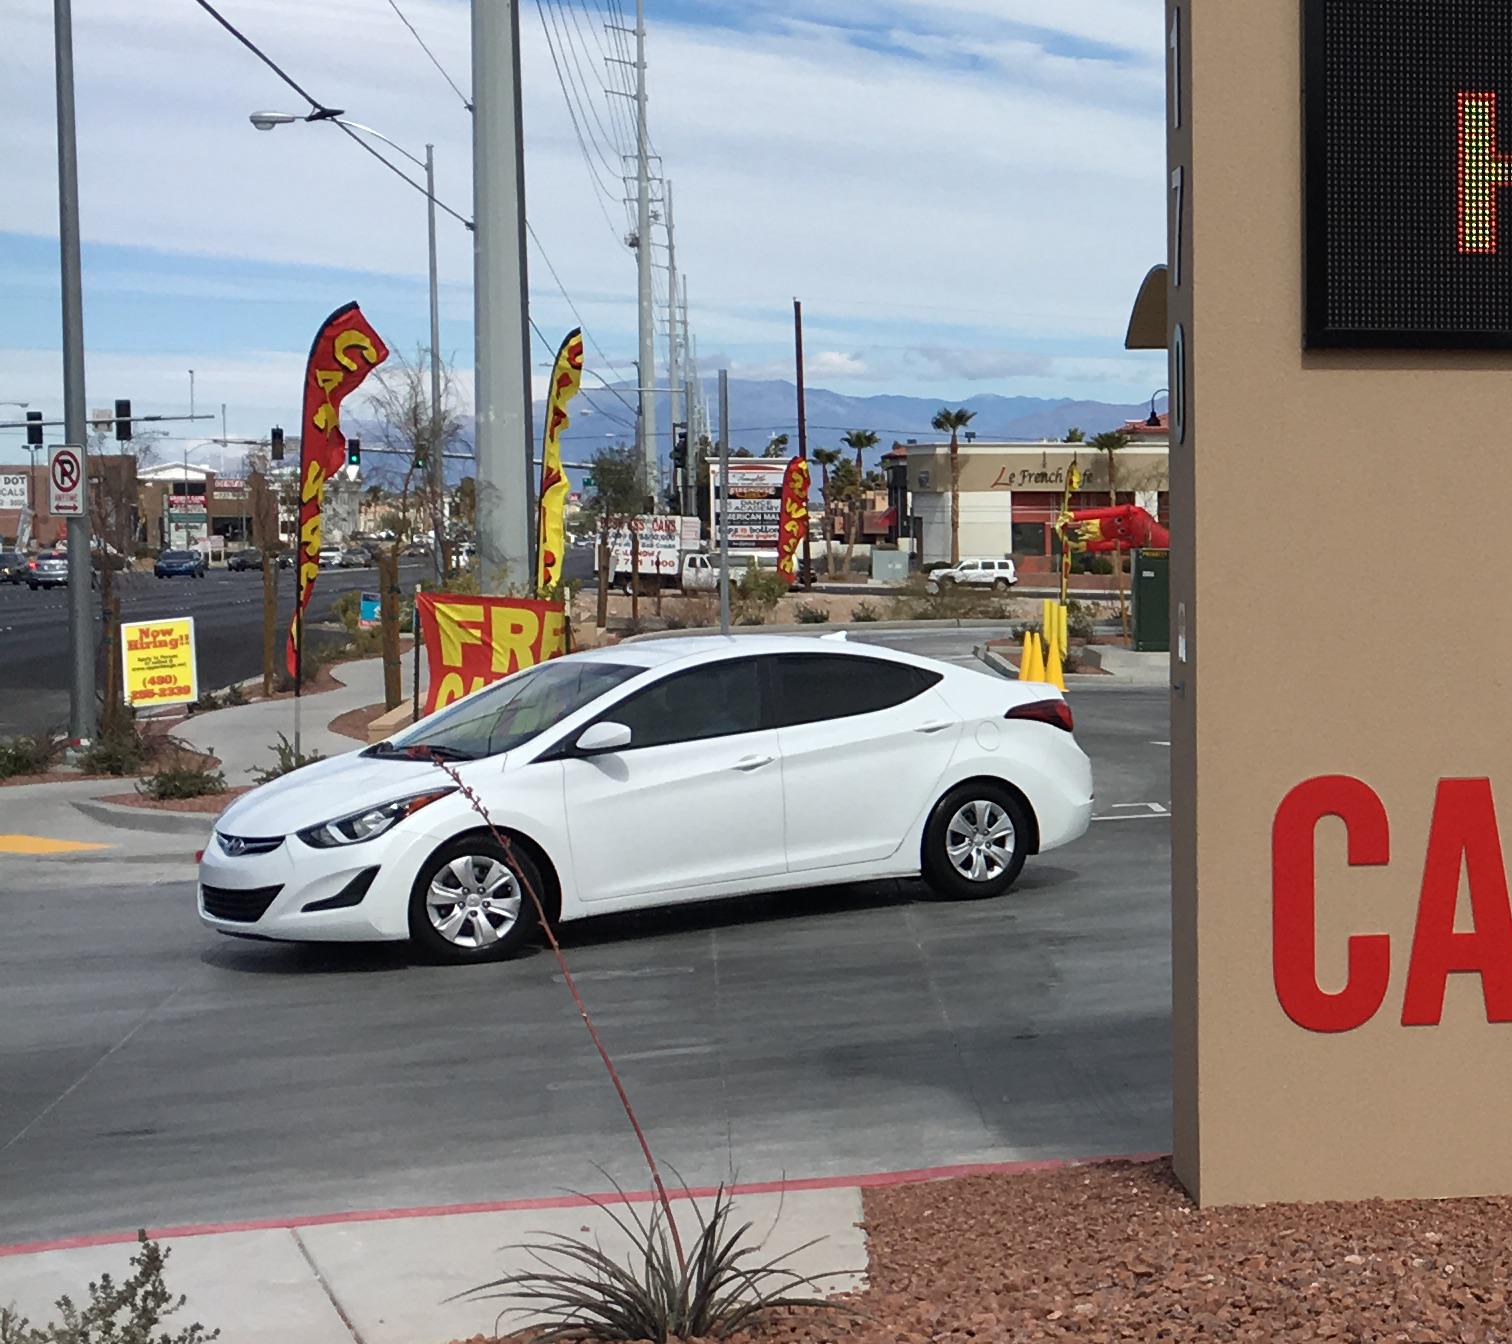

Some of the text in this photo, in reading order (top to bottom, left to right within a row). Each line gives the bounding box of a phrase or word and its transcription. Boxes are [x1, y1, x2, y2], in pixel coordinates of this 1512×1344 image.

[4, 476, 26, 485] DOT
[1018, 467, 1063, 486] French
[139, 628, 174, 638] Now
